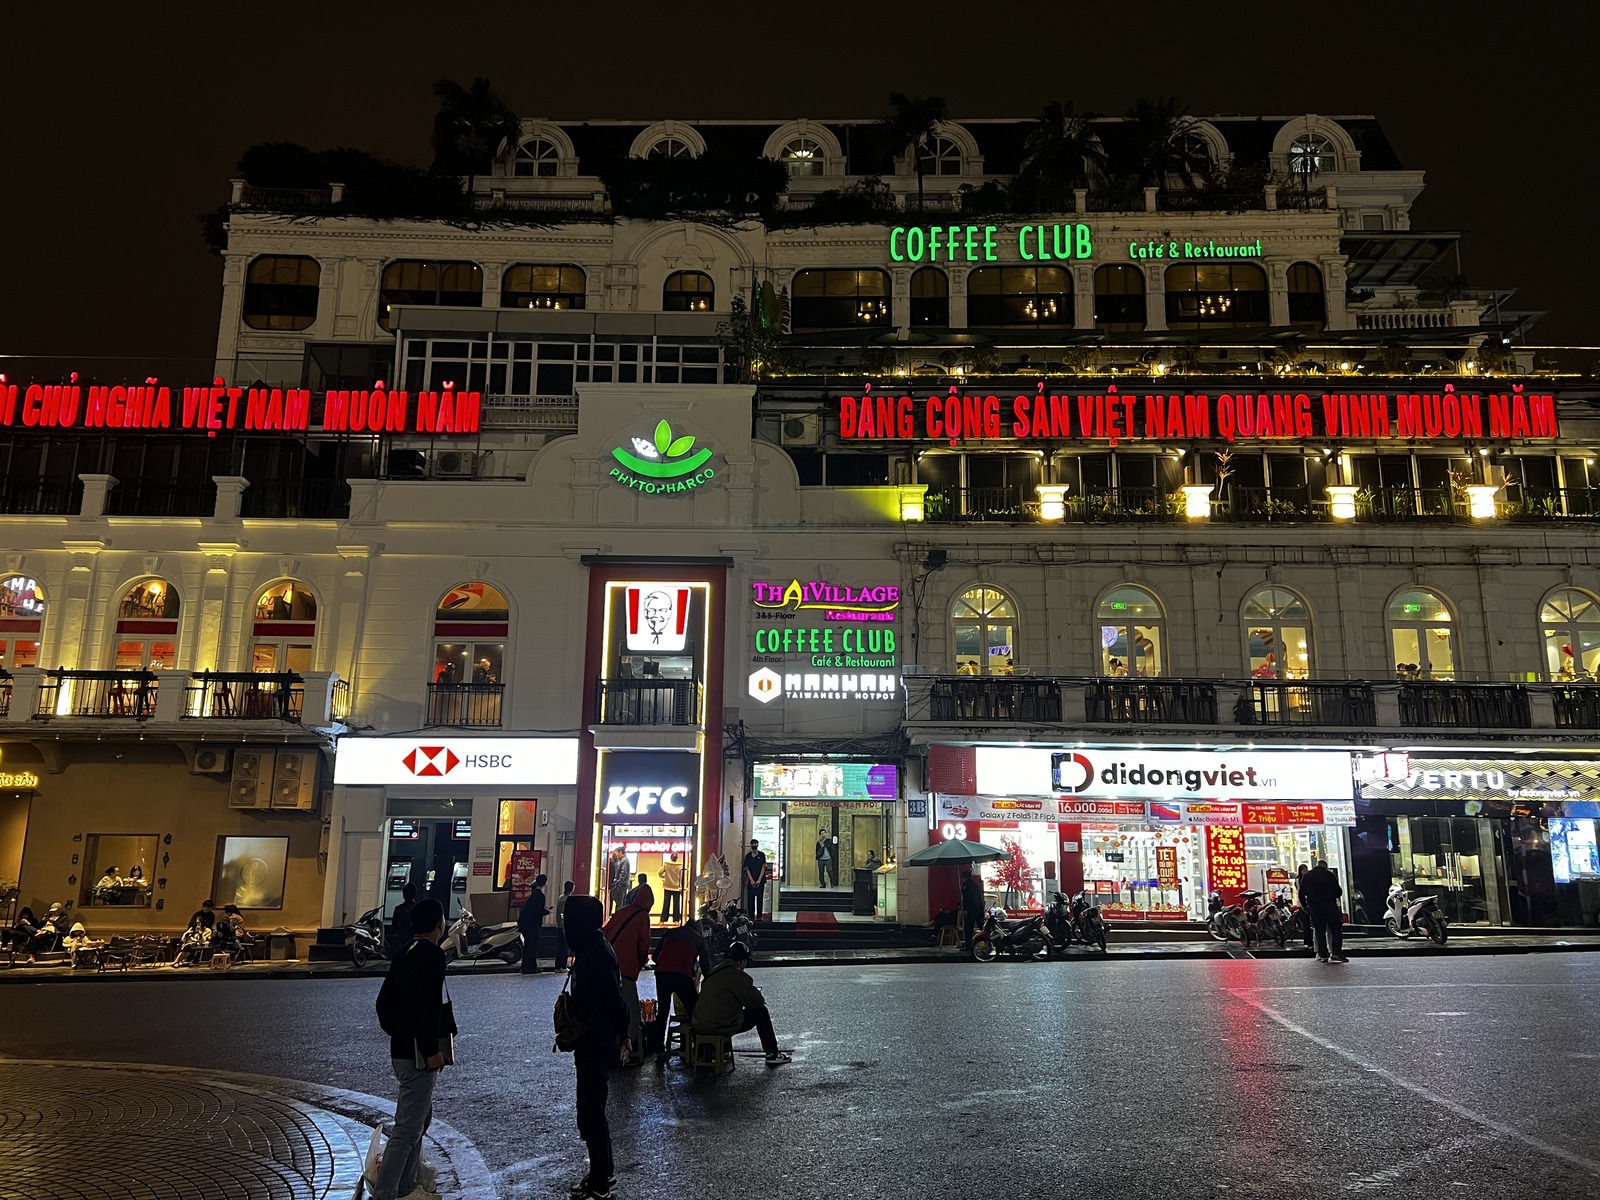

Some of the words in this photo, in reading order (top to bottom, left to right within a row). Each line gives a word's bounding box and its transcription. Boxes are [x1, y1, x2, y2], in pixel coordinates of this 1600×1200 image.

[890, 225, 998, 262] COFFEE
[1019, 223, 1092, 260] CLUB
[1129, 241, 1164, 259] Café
[1169, 241, 1180, 258] &
[1184, 239, 1262, 258] Restaurant
[22, 371, 80, 428] CHỦ
[84, 377, 170, 429] NGHĨA
[182, 376, 242, 437] VIỆT
[244, 388, 310, 431] NAM
[323, 380, 406, 432] MUÔN
[416, 380, 481, 432] NĂM
[839, 382, 914, 438] ĐẢNG
[925, 385, 1001, 446] CỘNG
[1012, 381, 1070, 438] SẢN
[1076, 384, 1137, 447] VIỆT
[1145, 395, 1210, 437] NAM
[1216, 393, 1313, 442] QUANG
[1321, 394, 1389, 437] VINH
[1396, 383, 1482, 437] MUÔN
[1489, 383, 1557, 437] NĂM
[609, 468, 715, 494] PHYTOPHARCO
[825, 609, 895, 621] Restaurants
[755, 628, 833, 653] COFFEE
[843, 628, 896, 653] CLUB
[811, 655, 832, 667] Café
[835, 656, 843, 667] &
[845, 655, 896, 667] Restaurant
[855, 692, 896, 700] HOTPOT
[465, 754, 513, 768] HSBC
[1405, 770, 1505, 790] VERTU
[602, 786, 688, 815] KFC
[909, 800, 925, 813] 3B
[1060, 802, 1097, 813] 16.000
[980, 811, 1006, 820] Galaxy
[1248, 811, 1257, 822] 2
[1258, 815, 1277, 823] Triệu
[942, 823, 967, 841] 03
[1158, 847, 1174, 861] TẾT
